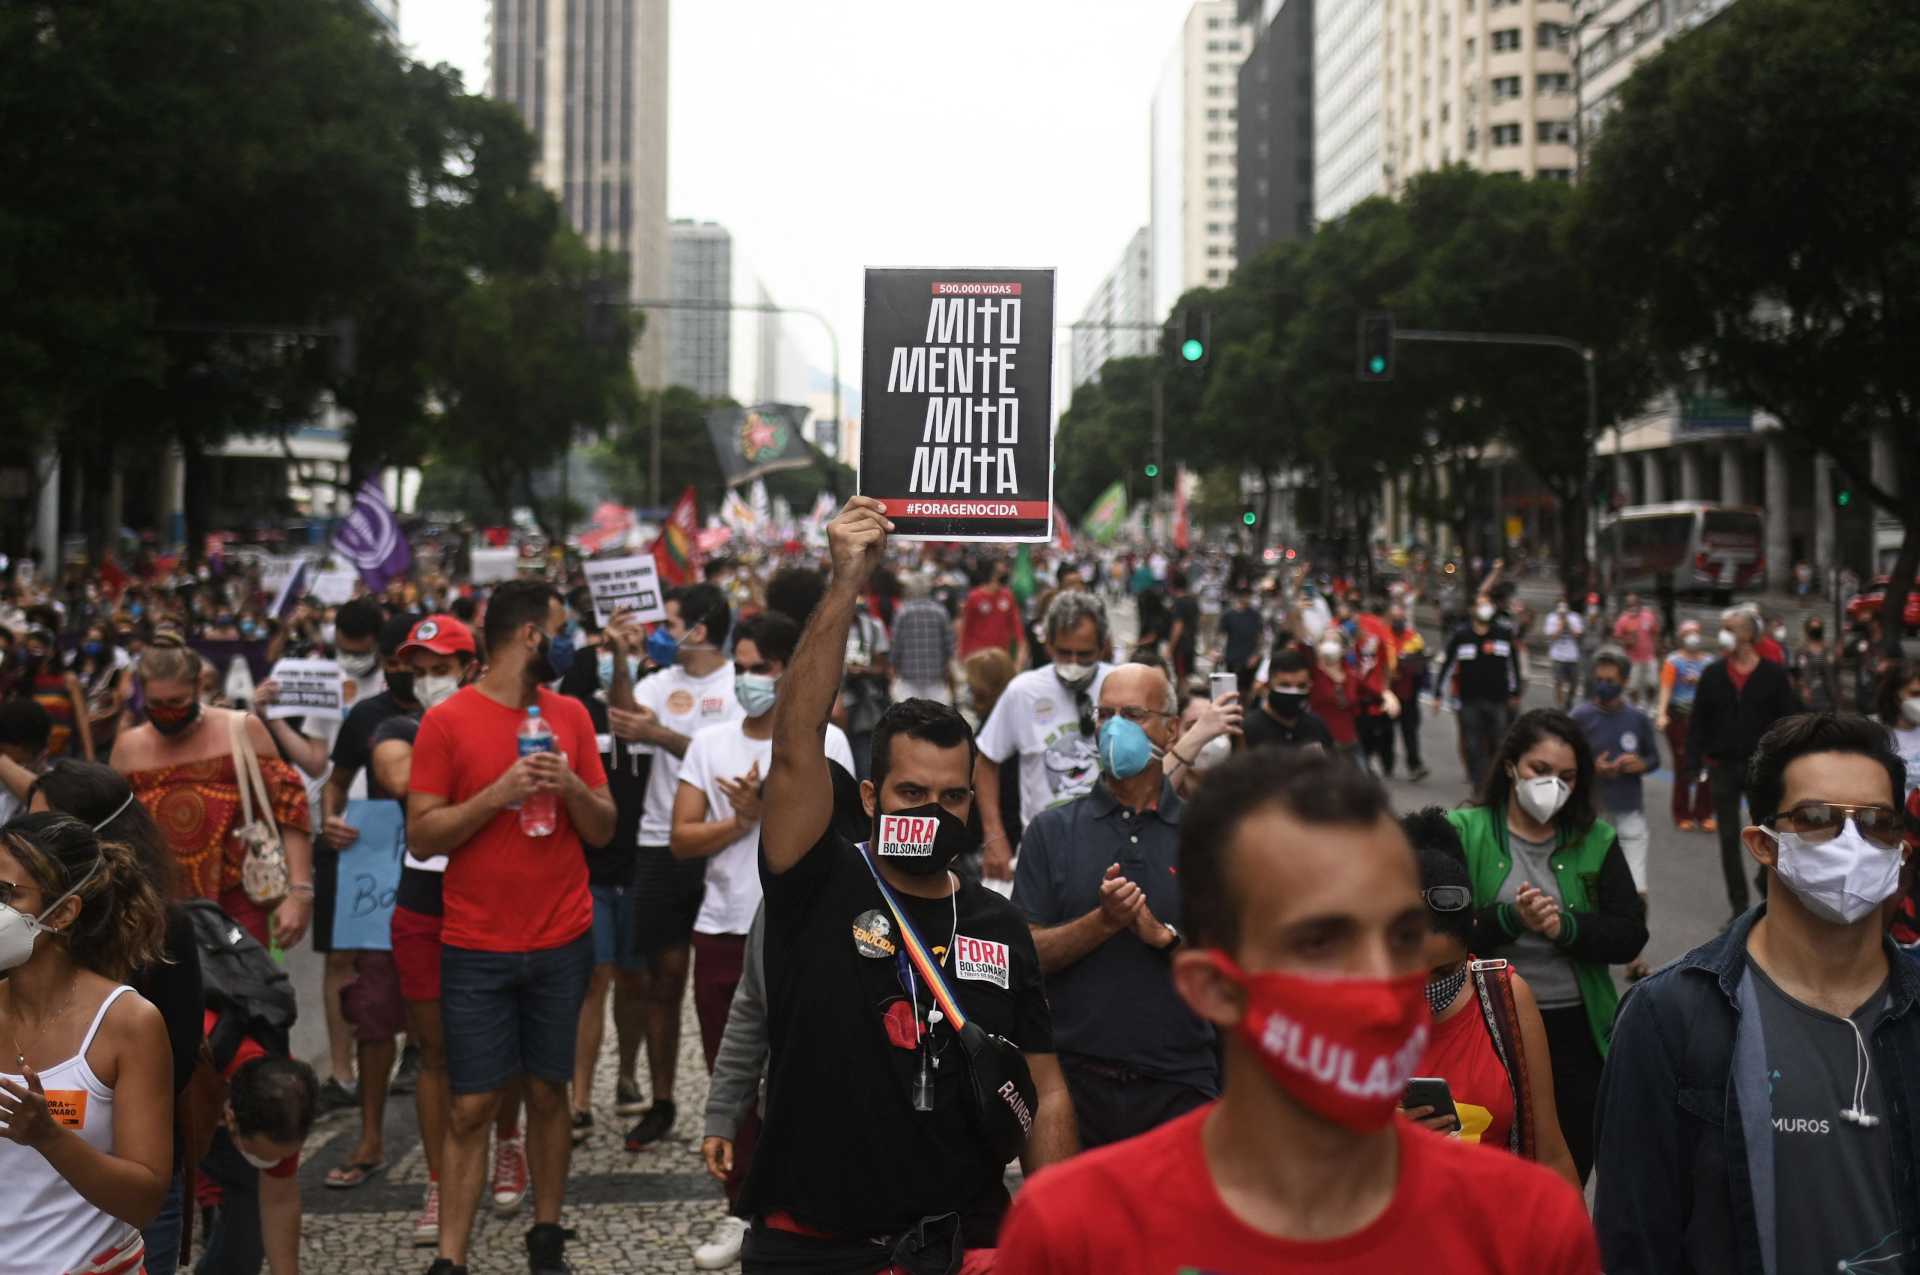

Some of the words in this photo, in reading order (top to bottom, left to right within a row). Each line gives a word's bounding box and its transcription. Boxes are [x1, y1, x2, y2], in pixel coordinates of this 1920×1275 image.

[940, 284, 980, 295] 500.000
[982, 285, 1011, 294] VIDAS
[906, 503, 1018, 516] #FORAGENOCIDA
[883, 817, 935, 844] FORA
[958, 937, 1007, 968] FORA
[960, 961, 1007, 979] BOLSONARO
[47, 1100, 64, 1108] ORA
[48, 1108, 77, 1116] ONARO
[998, 1080, 1032, 1137] RAINBO
[1771, 1118, 1830, 1134] MUROS
